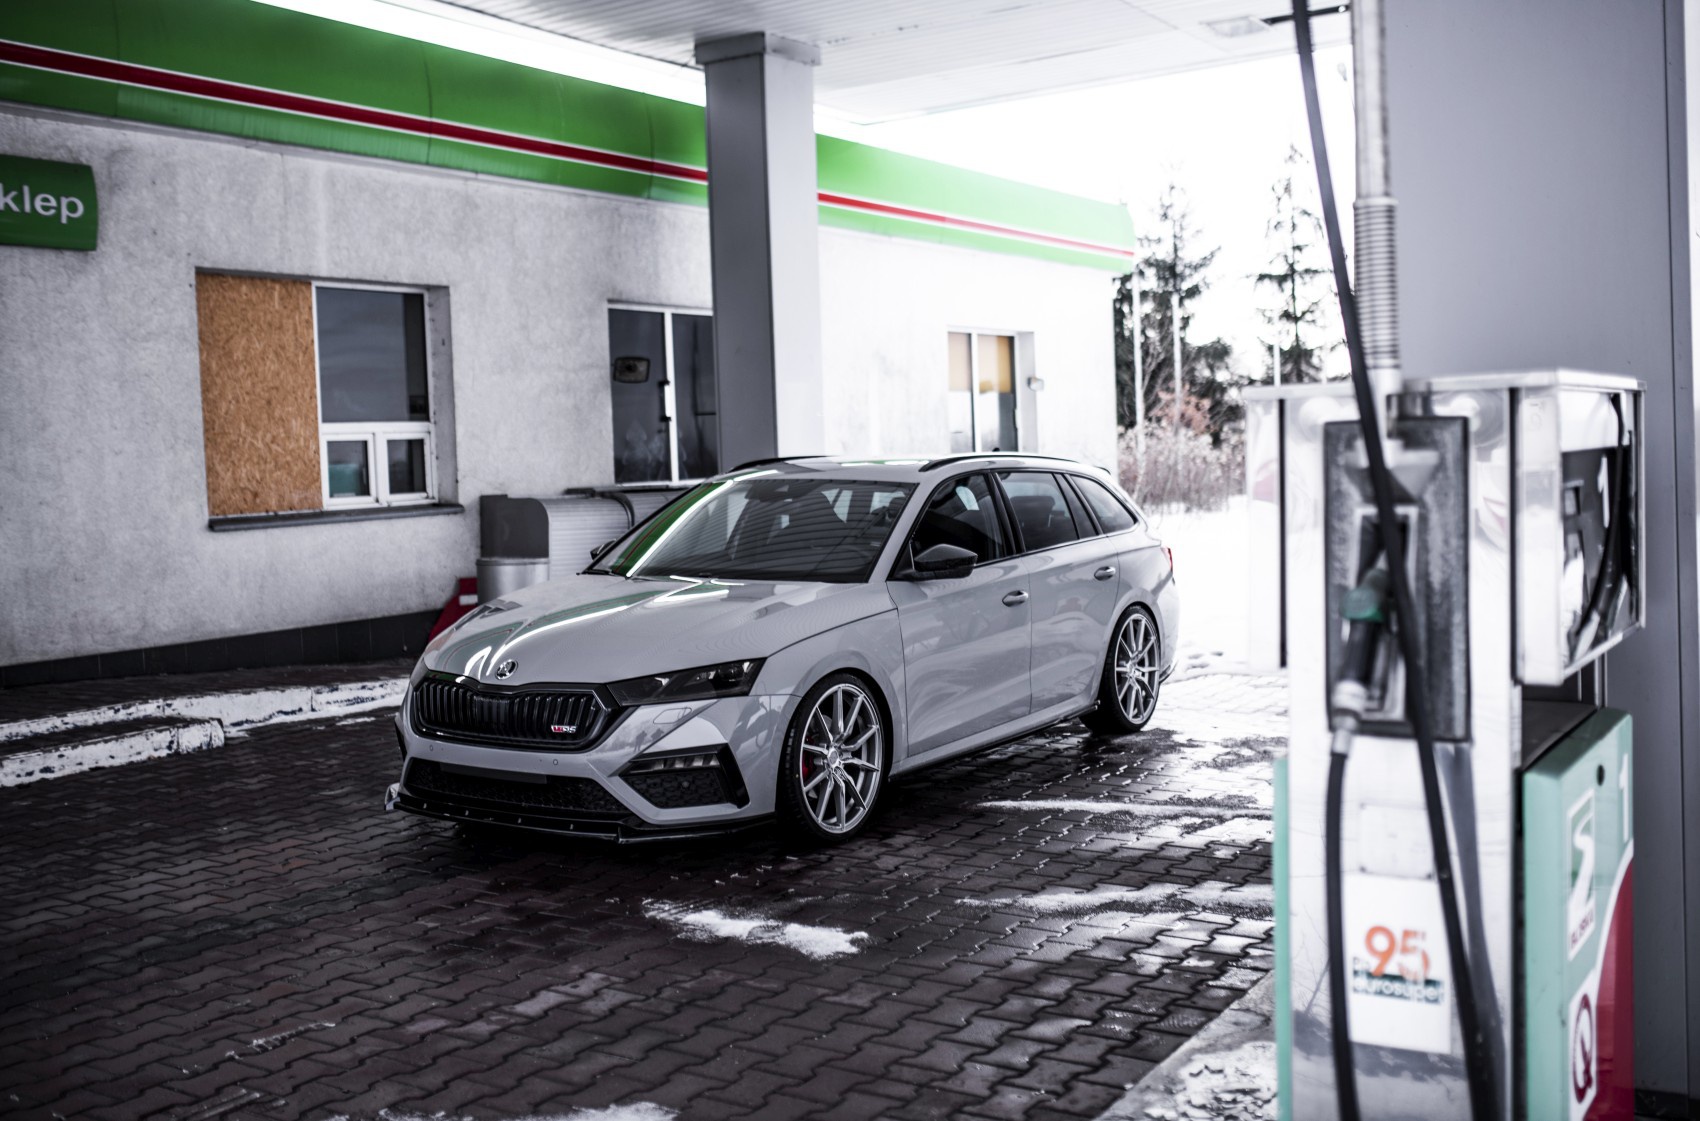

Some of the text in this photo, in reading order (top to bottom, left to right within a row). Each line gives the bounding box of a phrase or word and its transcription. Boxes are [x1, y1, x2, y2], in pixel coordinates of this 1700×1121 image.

[0, 182, 84, 225] klep
[1619, 753, 1630, 844] 1
[1364, 925, 1431, 983] 95
